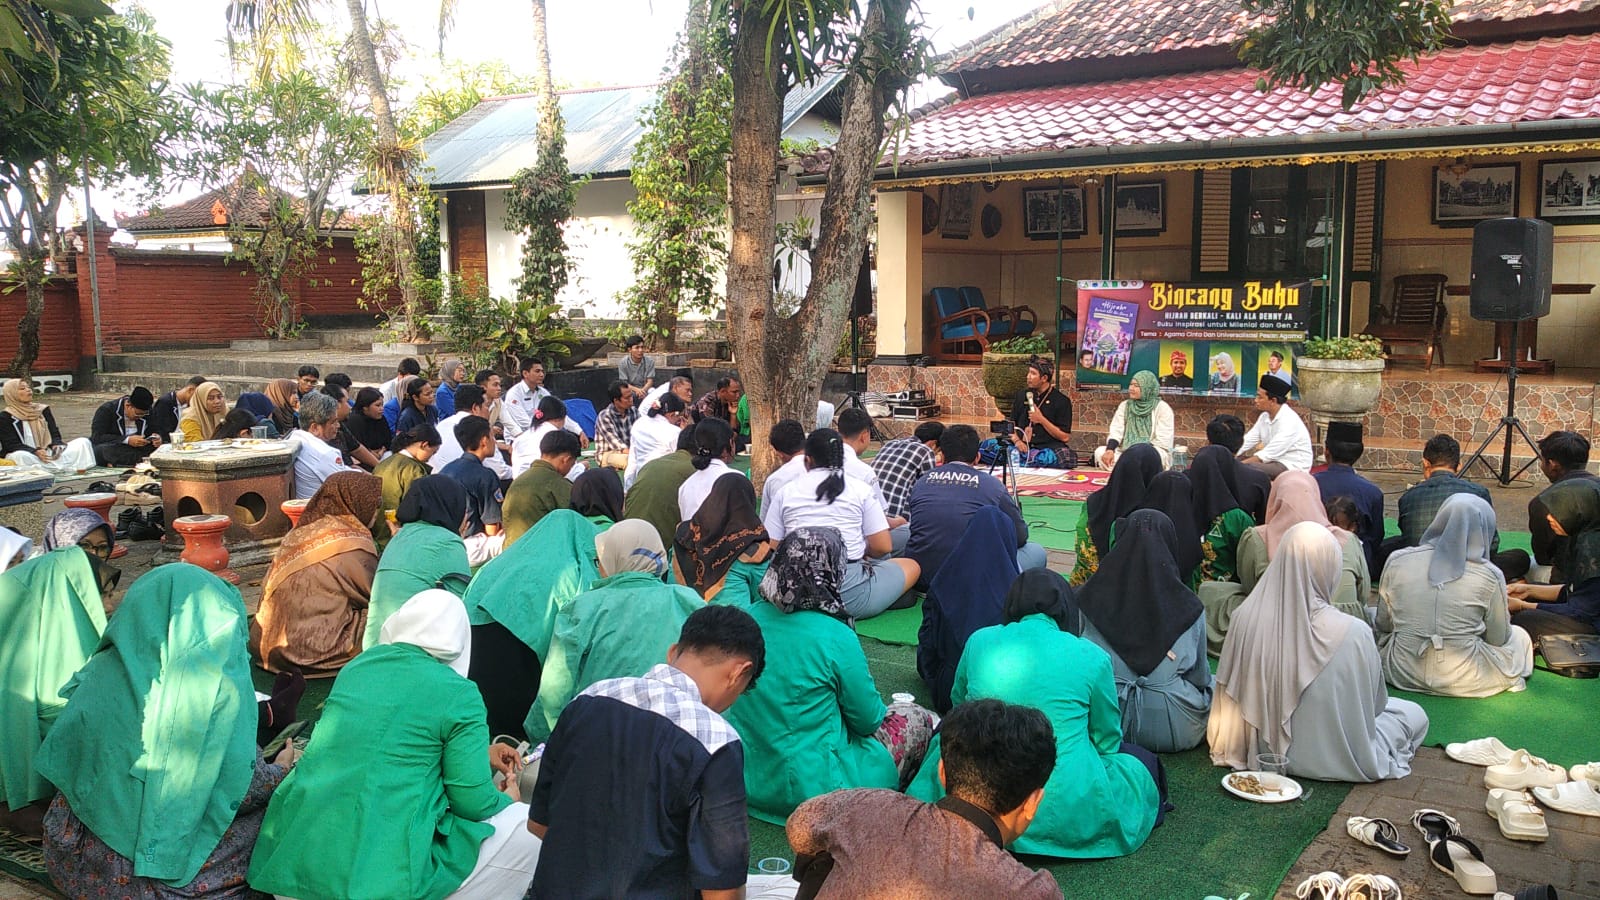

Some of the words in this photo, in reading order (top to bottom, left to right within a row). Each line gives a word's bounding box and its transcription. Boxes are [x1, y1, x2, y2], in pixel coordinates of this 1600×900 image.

[1148, 282, 1233, 311] Bincang
[1241, 280, 1300, 311] Buku
[1164, 311, 1188, 320] HIJRAH
[1190, 311, 1218, 320] BERKALI
[1226, 312, 1242, 320] KALI
[1243, 312, 1257, 320] ALA
[1259, 312, 1282, 321] DENNY
[1284, 312, 1293, 321] JA
[1175, 320, 1205, 329] Inspirasi
[927, 471, 979, 484] SMANDA
